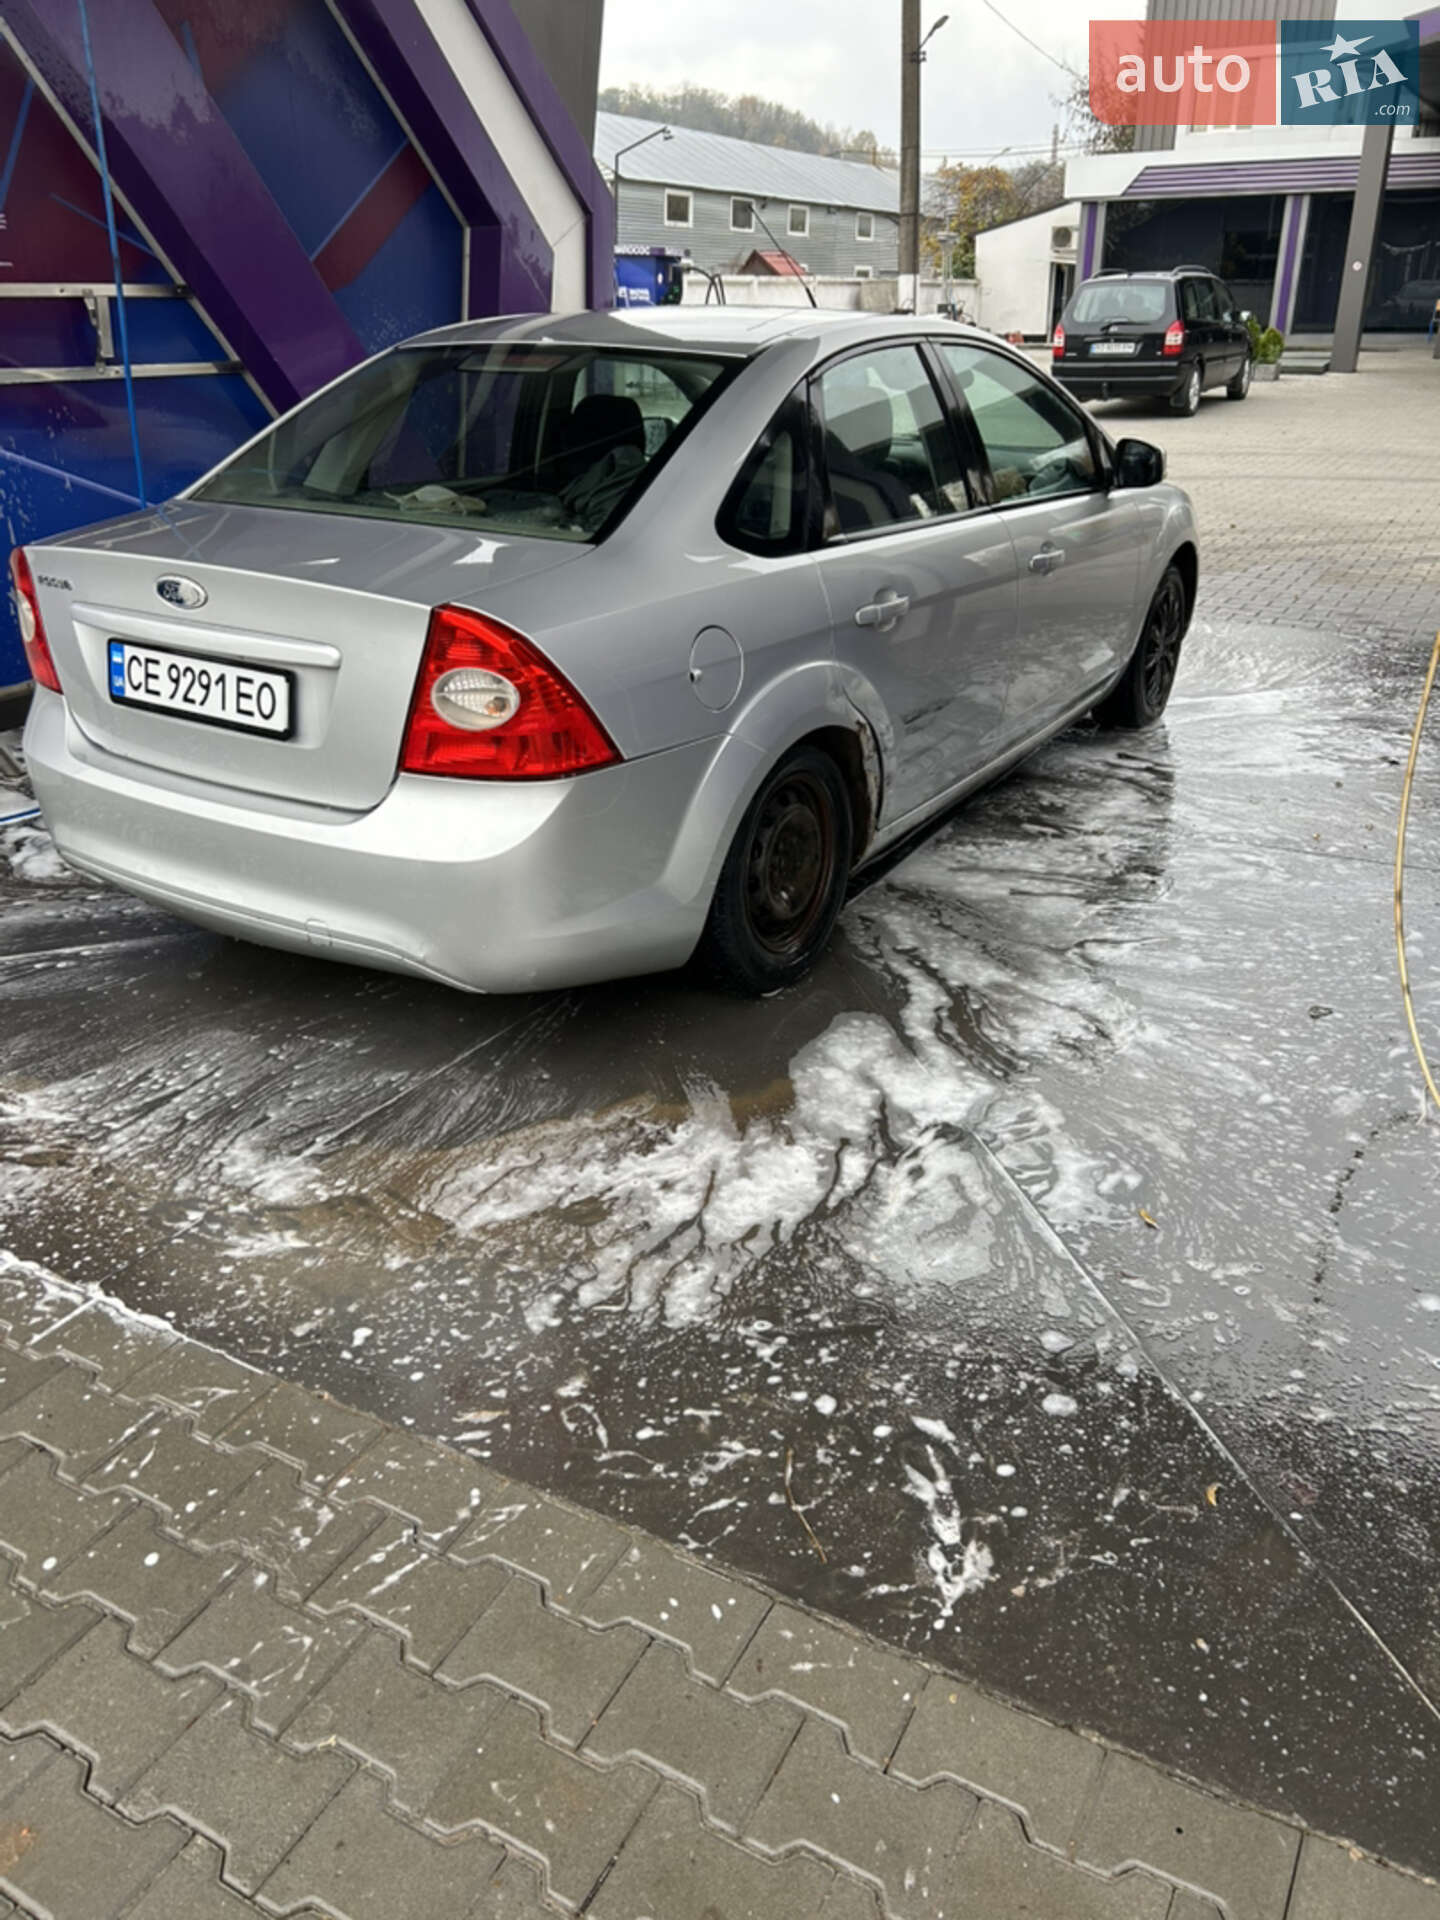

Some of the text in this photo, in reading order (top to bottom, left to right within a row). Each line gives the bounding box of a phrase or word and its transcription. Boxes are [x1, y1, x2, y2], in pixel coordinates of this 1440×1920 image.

[127, 654, 277, 721] CE 9291 EO
